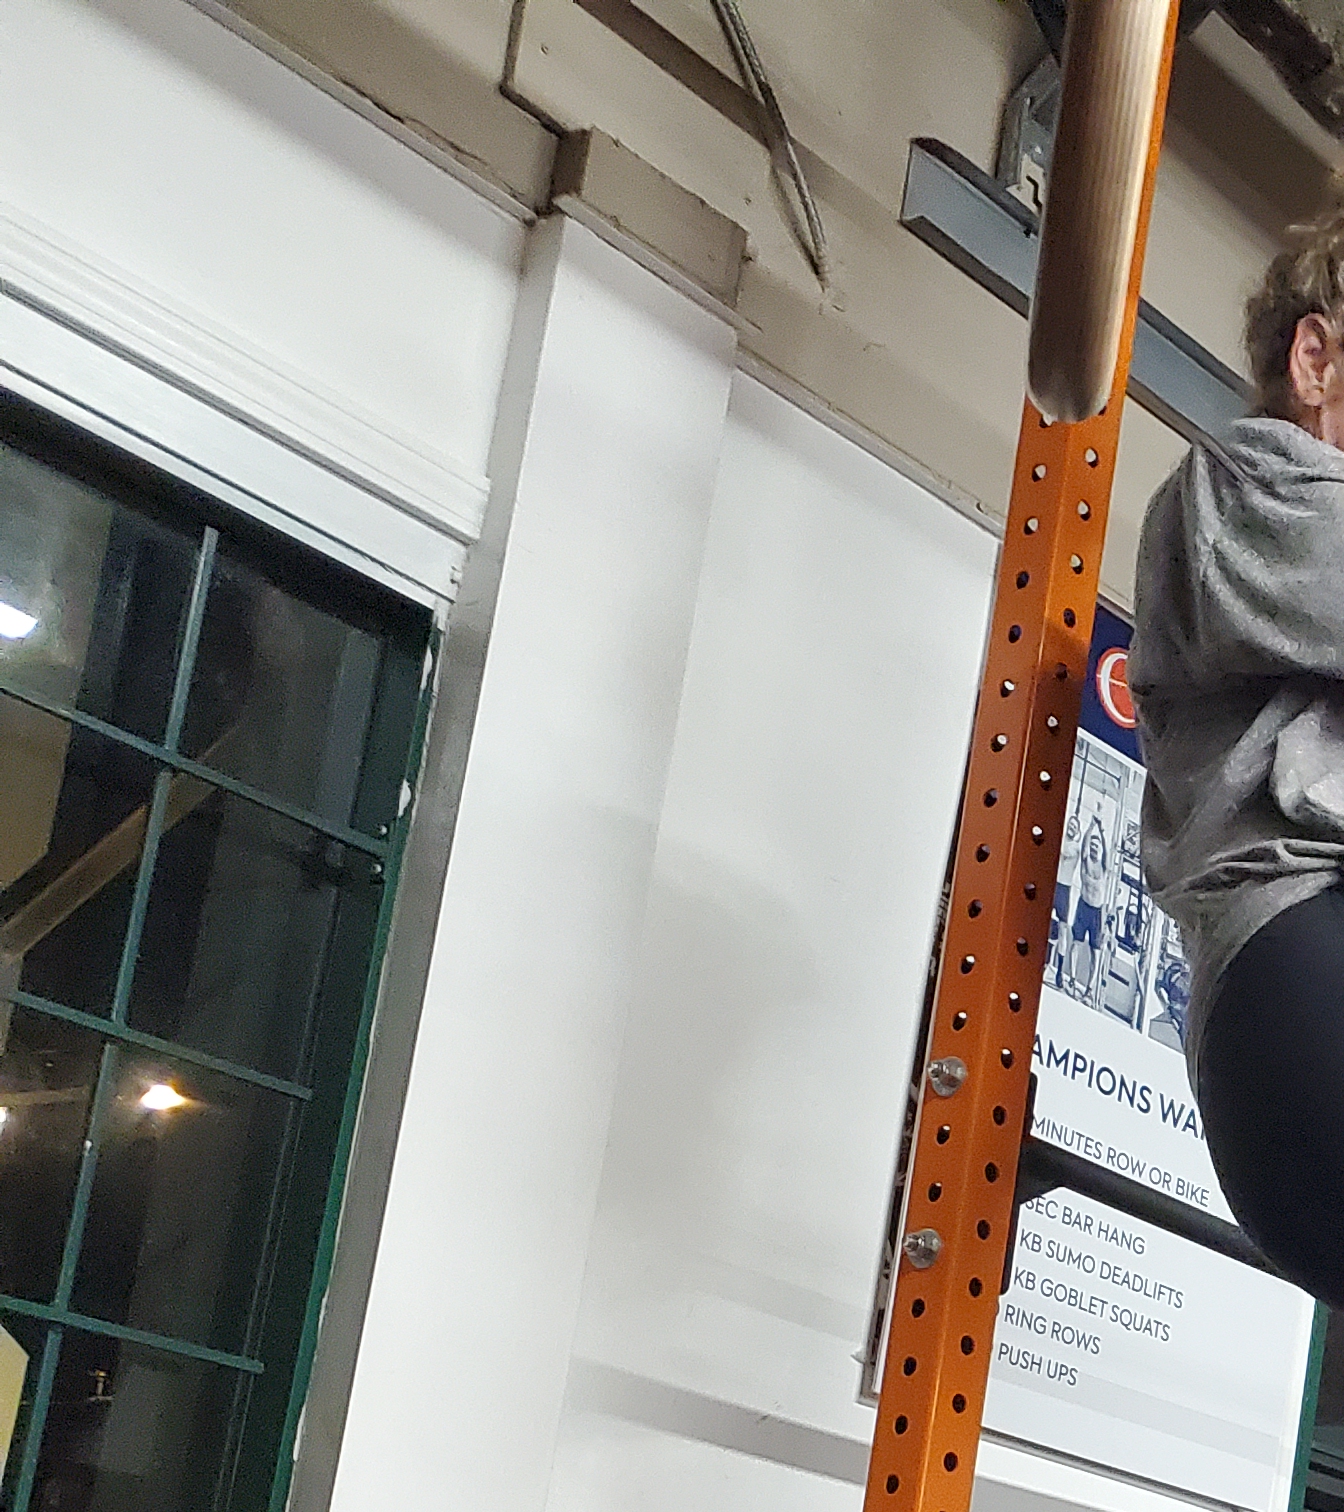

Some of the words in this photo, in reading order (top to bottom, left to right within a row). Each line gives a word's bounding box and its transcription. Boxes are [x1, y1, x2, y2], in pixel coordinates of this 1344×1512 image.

[1031, 1033, 1152, 1114] AMPIONS
[1159, 1092, 1206, 1141] WA
[1034, 1116, 1103, 1160] MINUTES
[1106, 1146, 1147, 1179] ROW
[1149, 1167, 1172, 1192] OR
[1175, 1177, 1210, 1208] BIKE
[1025, 1197, 1058, 1220] SEC
[1061, 1206, 1094, 1235] BAR
[1097, 1220, 1146, 1255] HANG
[1013, 1266, 1036, 1291] KB
[1040, 1278, 1108, 1318] GOBLET
[1109, 1305, 1172, 1342] SQUATS
[1019, 1228, 1043, 1253] KB
[1045, 1240, 1096, 1274] SUMO
[1099, 1261, 1184, 1309] DEADLIFTS
[998, 1342, 1043, 1375] PUSH
[1046, 1359, 1079, 1387] UPS
[1004, 1304, 1047, 1335] RING
[1050, 1321, 1101, 1355] ROWS
